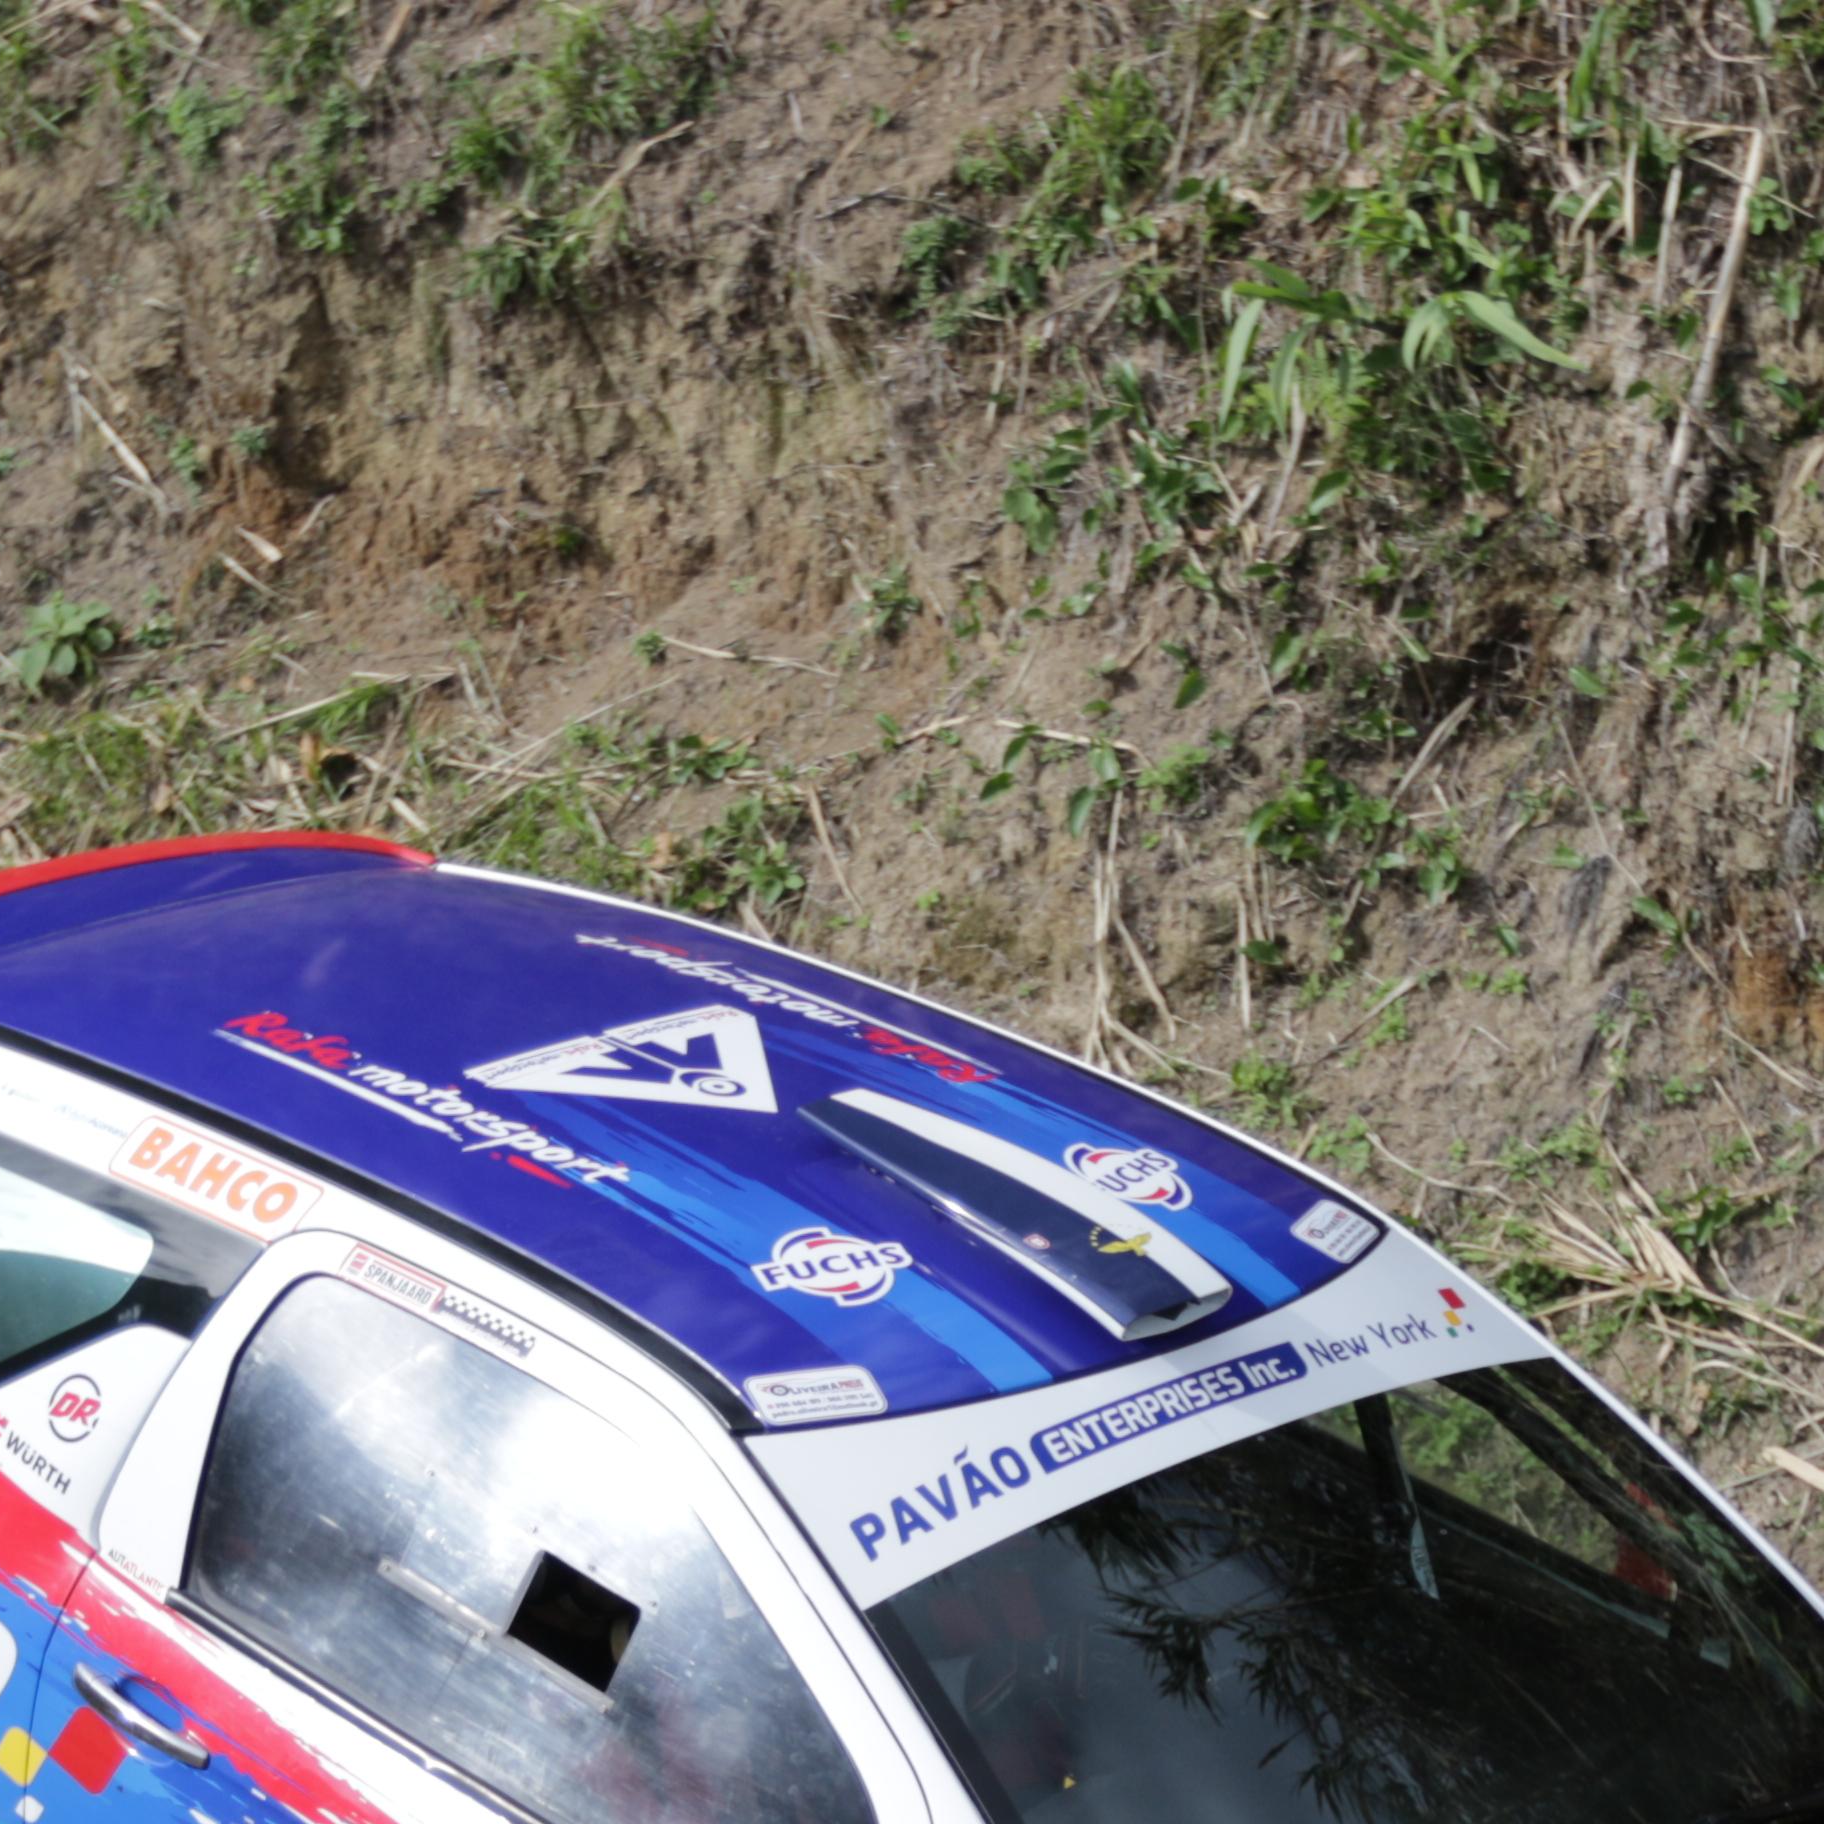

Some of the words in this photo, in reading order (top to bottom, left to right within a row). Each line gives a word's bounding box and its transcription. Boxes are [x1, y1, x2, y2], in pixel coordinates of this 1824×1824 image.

[574, 933, 861, 1029] motorsport
[223, 1011, 352, 1069] Rafa
[348, 1063, 631, 1184] motorsport
[128, 1127, 298, 1223] BAHCO
[1095, 1151, 1170, 1192] UCHS
[364, 1264, 433, 1305] SPANJAARD
[761, 1246, 904, 1285] FUCHS
[6, 1429, 72, 1494] WÜRTH
[849, 1443, 1031, 1562] PAVÃO
[1042, 1366, 1244, 1463] ENTERPRISES
[1239, 1355, 1297, 1388] Inc.
[1305, 1333, 1370, 1367] New
[1367, 1314, 1436, 1349] York
